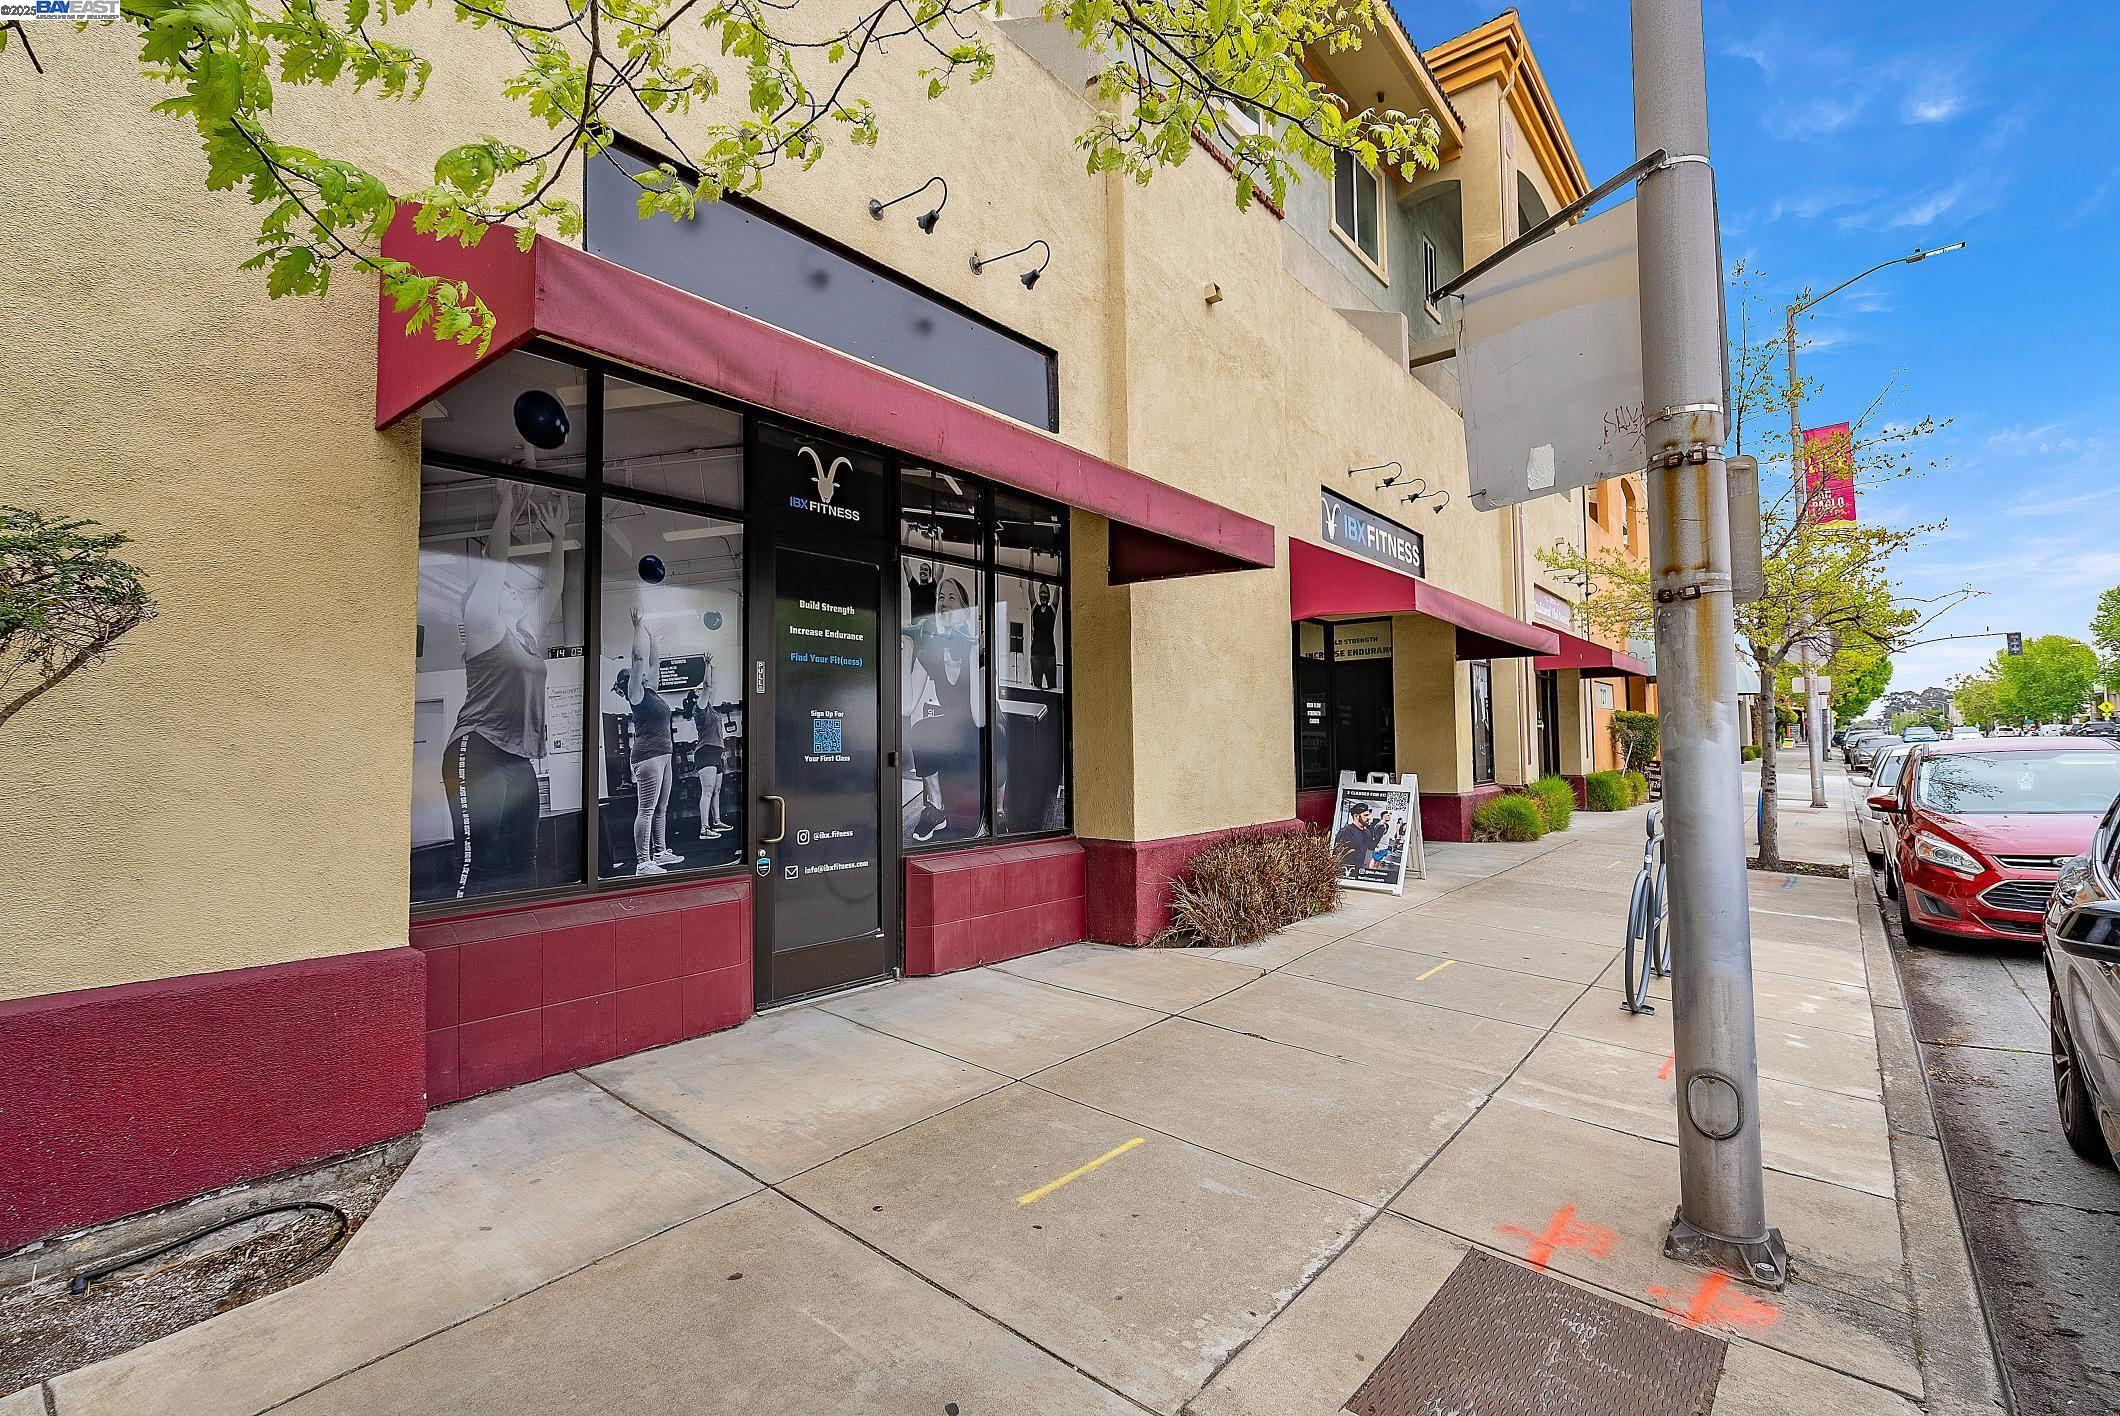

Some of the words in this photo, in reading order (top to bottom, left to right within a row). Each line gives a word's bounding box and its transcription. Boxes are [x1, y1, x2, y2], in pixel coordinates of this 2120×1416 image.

[799, 599, 821, 610] Build
[821, 602, 855, 616] Strength
[789, 625, 824, 637] Increase
[824, 629, 864, 641] Endurance
[1344, 636, 1378, 645] STRENGTH
[790, 652, 808, 662] Find
[809, 654, 829, 664] Your
[829, 656, 863, 668] Fit(ness)
[810, 710, 825, 718] Sign
[813, 830, 854, 840] @ibx.fitness
[804, 861, 869, 874] info@ibxfitness.com
